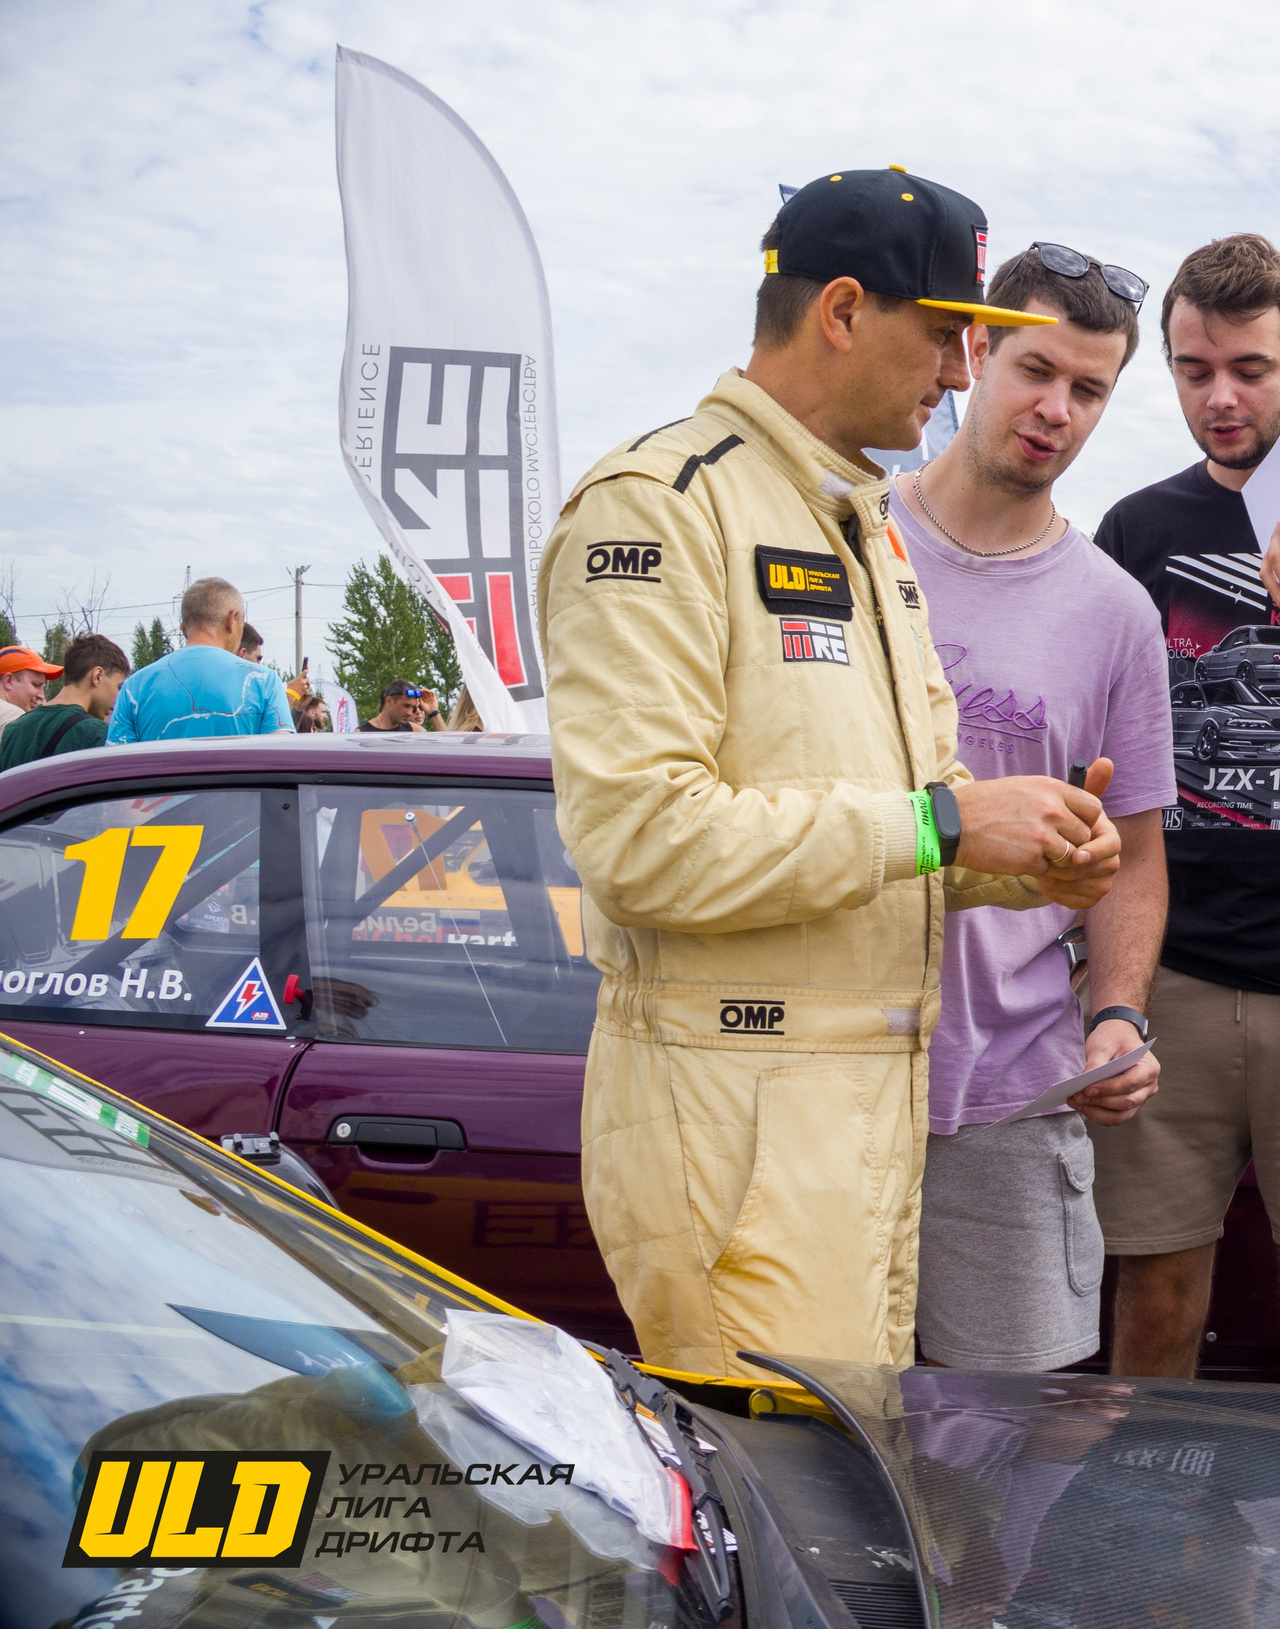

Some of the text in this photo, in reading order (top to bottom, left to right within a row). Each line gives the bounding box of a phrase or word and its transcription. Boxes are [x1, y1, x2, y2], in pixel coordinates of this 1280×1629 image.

[586, 546, 662, 575] OMP
[769, 563, 806, 591] ULD
[1167, 648, 1196, 659] OLOR
[1236, 801, 1253, 810] TIME
[63, 825, 204, 940] 17
[119, 968, 193, 1001] Н.В.
[720, 1004, 785, 1030] OMP
